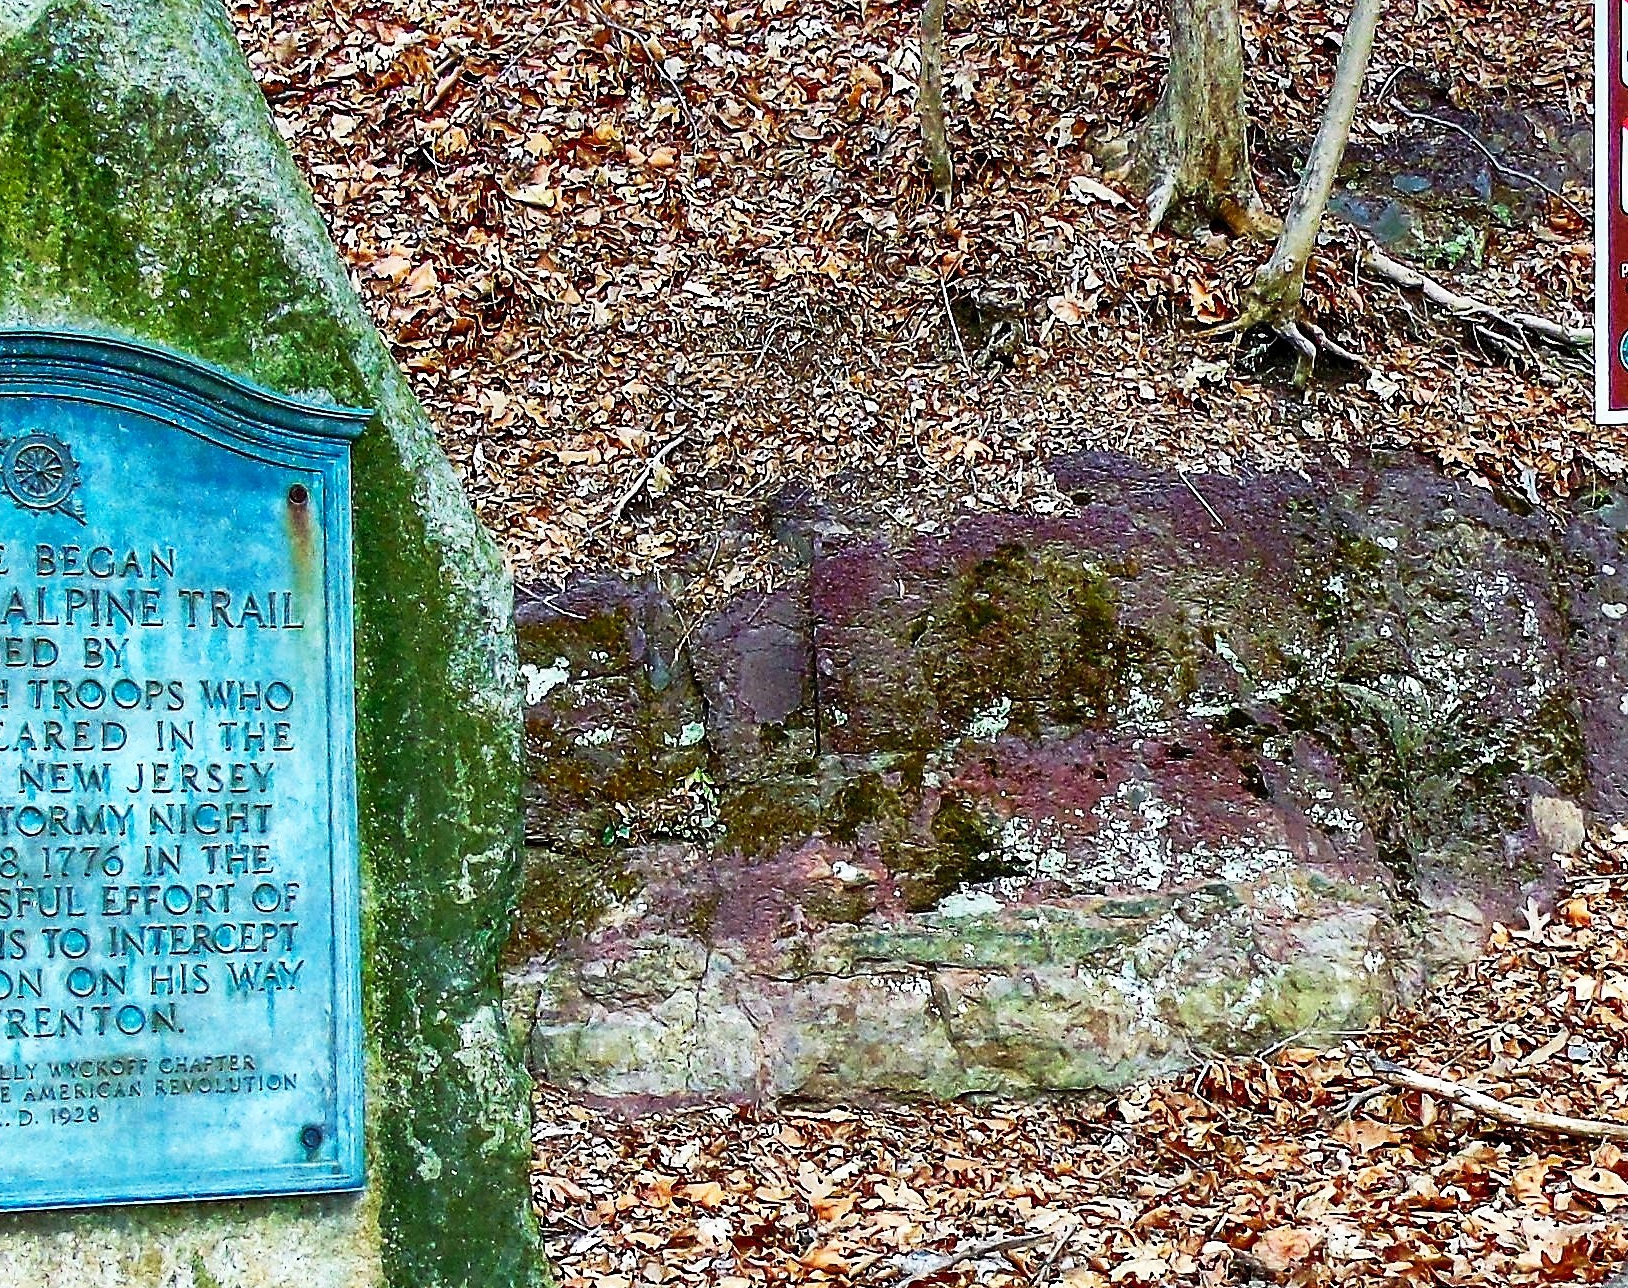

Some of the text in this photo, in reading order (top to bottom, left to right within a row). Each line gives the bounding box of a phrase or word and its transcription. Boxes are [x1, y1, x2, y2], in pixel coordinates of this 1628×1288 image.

[35, 544, 175, 579] BEGAN
[0, 586, 164, 627] ALPINE
[178, 589, 304, 629] TRAIL
[83, 637, 129, 669] BY
[27, 678, 185, 711] TROOPS
[199, 680, 294, 712] WHO
[157, 720, 194, 752] IN
[218, 720, 294, 752] THE
[18, 762, 111, 794] NEW
[126, 762, 274, 794] JERSEY
[149, 803, 273, 835] NIGHT
[42, 845, 124, 878] 1776
[144, 844, 183, 877] IN
[201, 844, 274, 874] THE
[102, 883, 236, 916] EFFORT
[252, 882, 300, 913] OF
[41, 927, 90, 959] TO
[109, 922, 299, 957] INTERCEPT
[66, 966, 127, 998] ON
[150, 963, 210, 995] HIS
[226, 960, 304, 992] WAY
[47, 1059, 148, 1079] WYCKOFF
[158, 1054, 256, 1074] CHAPTER
[23, 1081, 142, 1102] AMERICAN
[154, 1073, 297, 1097] REVOLUTION
[19, 1109, 40, 1128] D.
[51, 1105, 100, 1126] 1928
